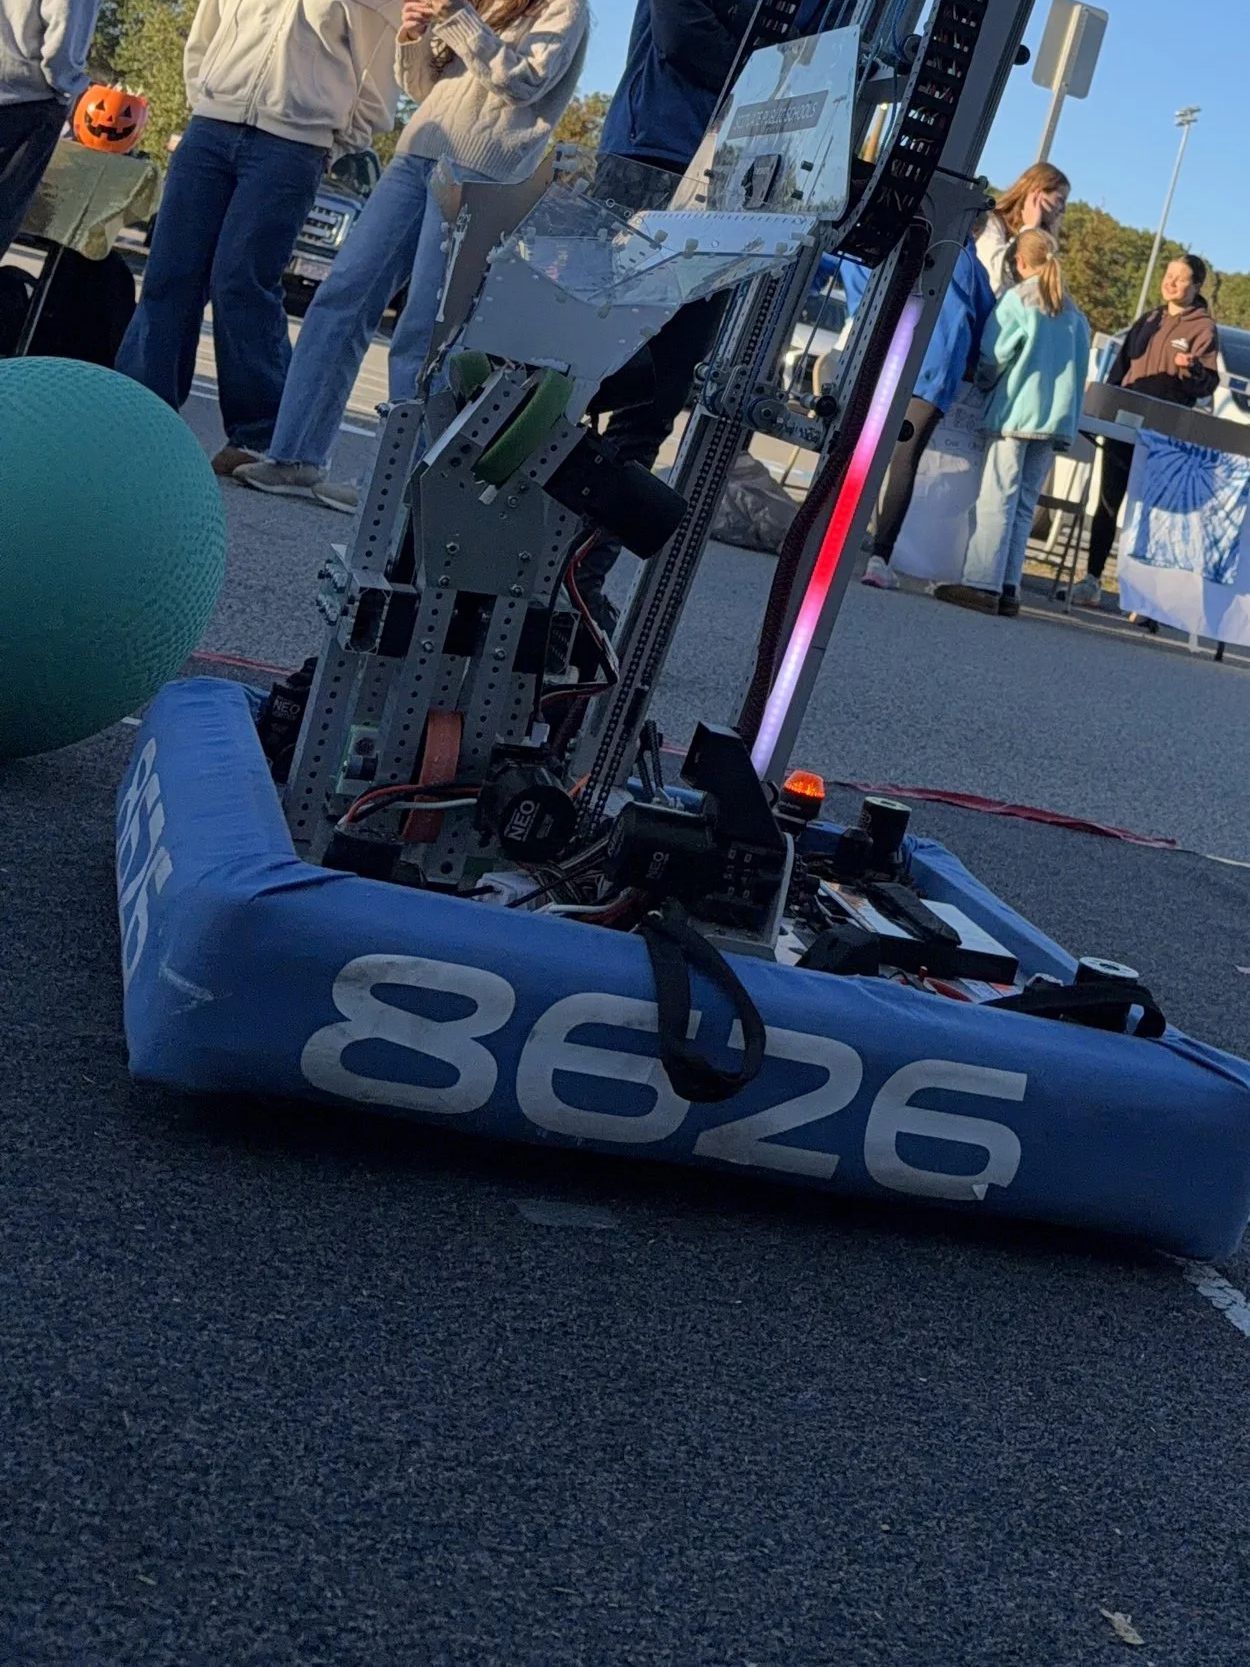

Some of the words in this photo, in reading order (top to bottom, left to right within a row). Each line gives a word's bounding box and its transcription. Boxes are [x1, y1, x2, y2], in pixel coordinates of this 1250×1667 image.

[273, 698, 301, 715] NEO
[508, 800, 535, 841] NEO
[301, 953, 1028, 1202] 8626
